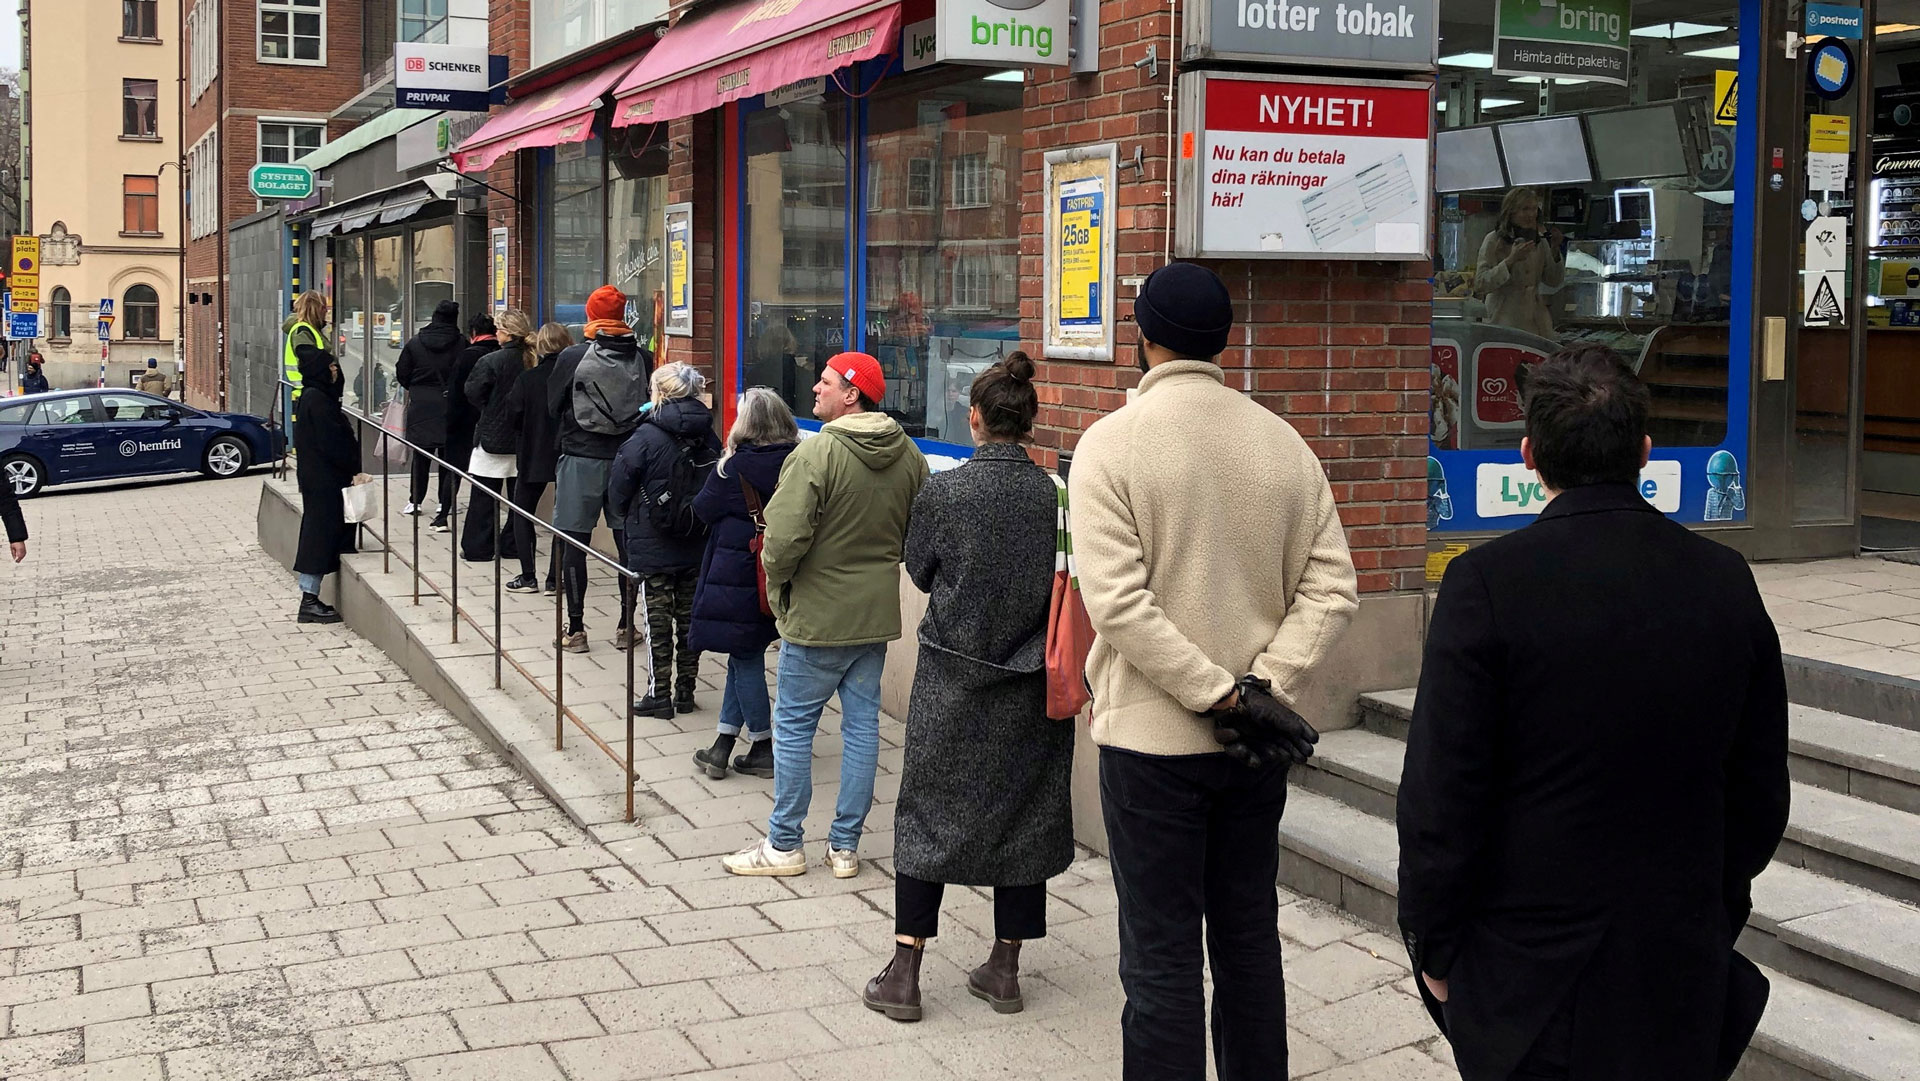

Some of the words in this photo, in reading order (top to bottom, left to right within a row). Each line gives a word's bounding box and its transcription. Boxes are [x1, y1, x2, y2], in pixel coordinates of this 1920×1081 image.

[1336, 3, 1414, 38] tobak
[1560, 2, 1620, 41] bring
[1820, 16, 1859, 26] postnord
[971, 15, 1053, 57] bring
[408, 60, 423, 70] DB
[428, 61, 482, 74] SCHENKER
[1513, 49, 1552, 64] Hämta
[1554, 52, 1576, 66] ditt
[1577, 55, 1608, 69] paket
[1609, 57, 1622, 70] här
[406, 92, 451, 103] PRIVPAK
[1259, 94, 1374, 128] NYHET!
[1212, 145, 1235, 161] Nu
[1239, 146, 1269, 162] kan
[1273, 147, 1294, 163] du
[1298, 148, 1346, 165] betala
[260, 172, 305, 182] SYSTEM
[1211, 168, 1246, 185] dina
[1250, 172, 1328, 190] räkningar
[257, 181, 308, 191] BOLAGET
[1067, 196, 1095, 210] FASTPRIS
[1211, 191, 1244, 207] här!
[16, 245, 36, 253] plats
[139, 439, 181, 451] hemfrid
